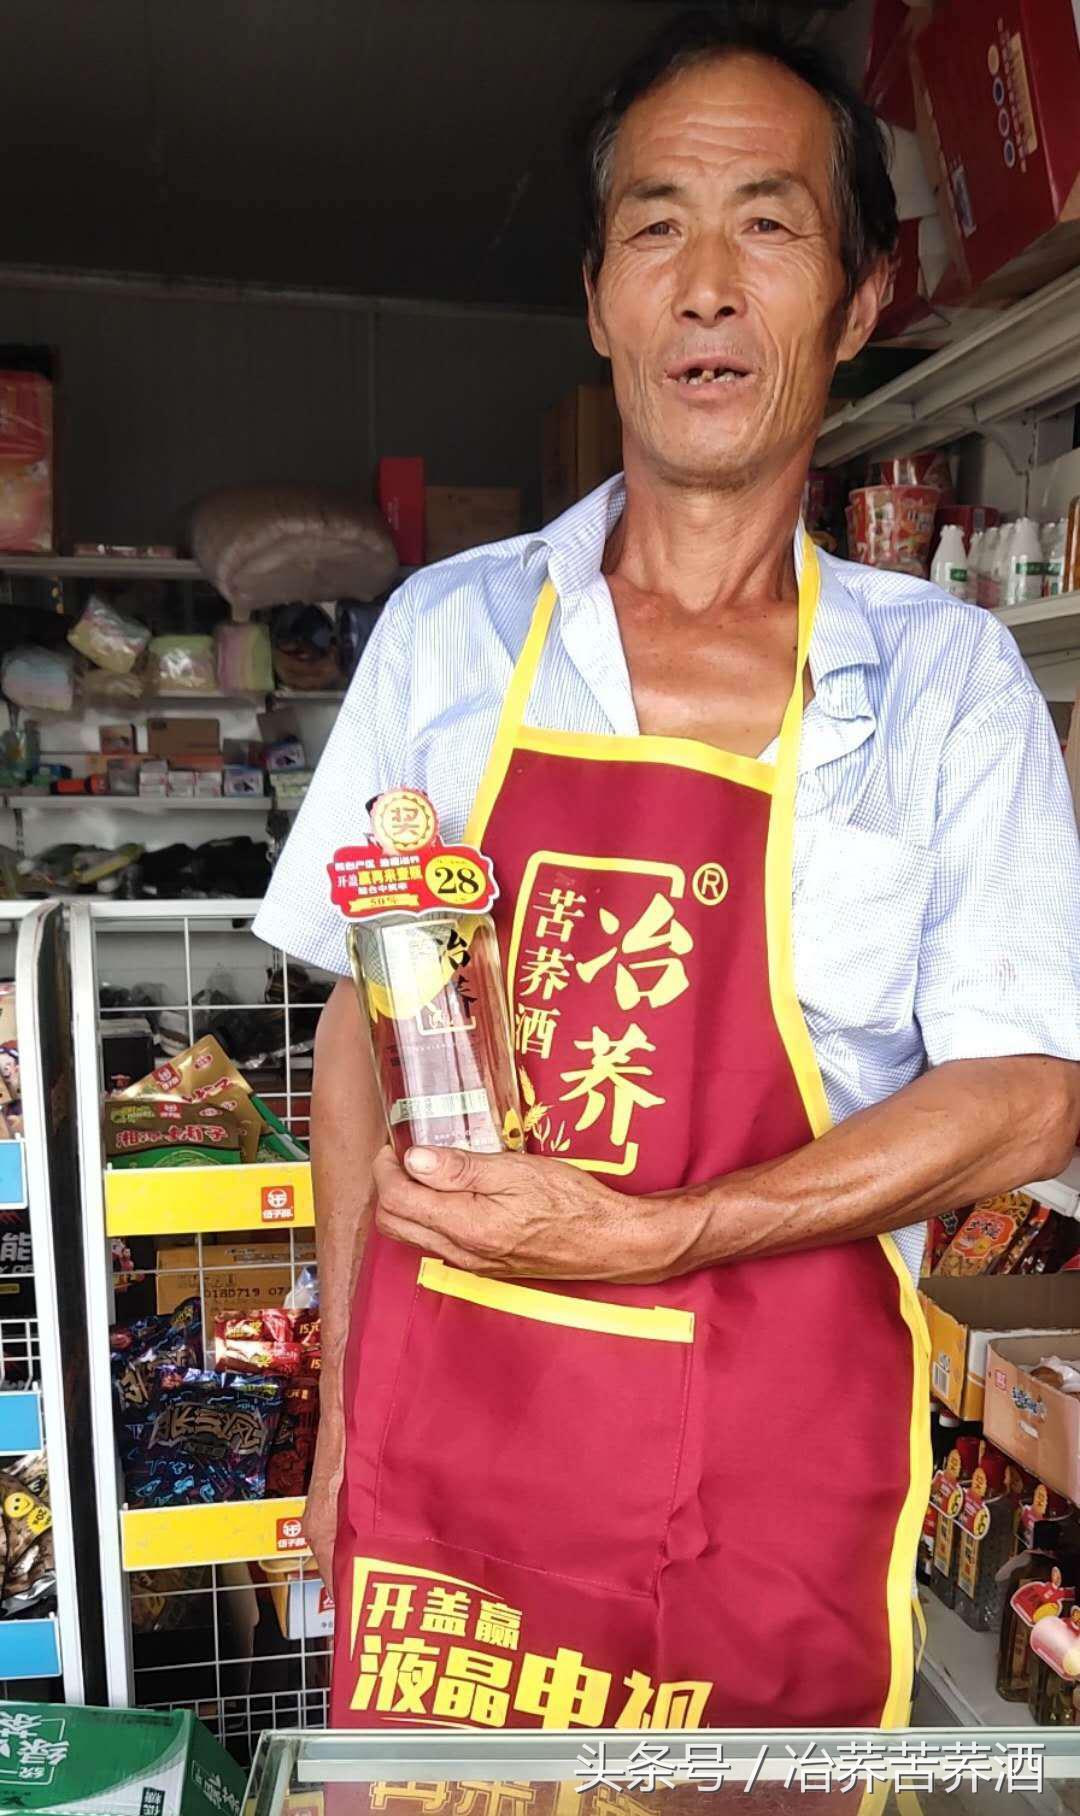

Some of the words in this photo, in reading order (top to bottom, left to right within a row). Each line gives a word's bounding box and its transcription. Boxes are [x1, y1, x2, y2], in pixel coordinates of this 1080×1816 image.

[434, 867, 480, 894] 28
[514, 888, 587, 1060] 苦荞酒
[558, 892, 695, 1147] 冶荞
[365, 1582, 523, 1651] 开盖赢
[350, 1634, 714, 1730] 液晶电视
